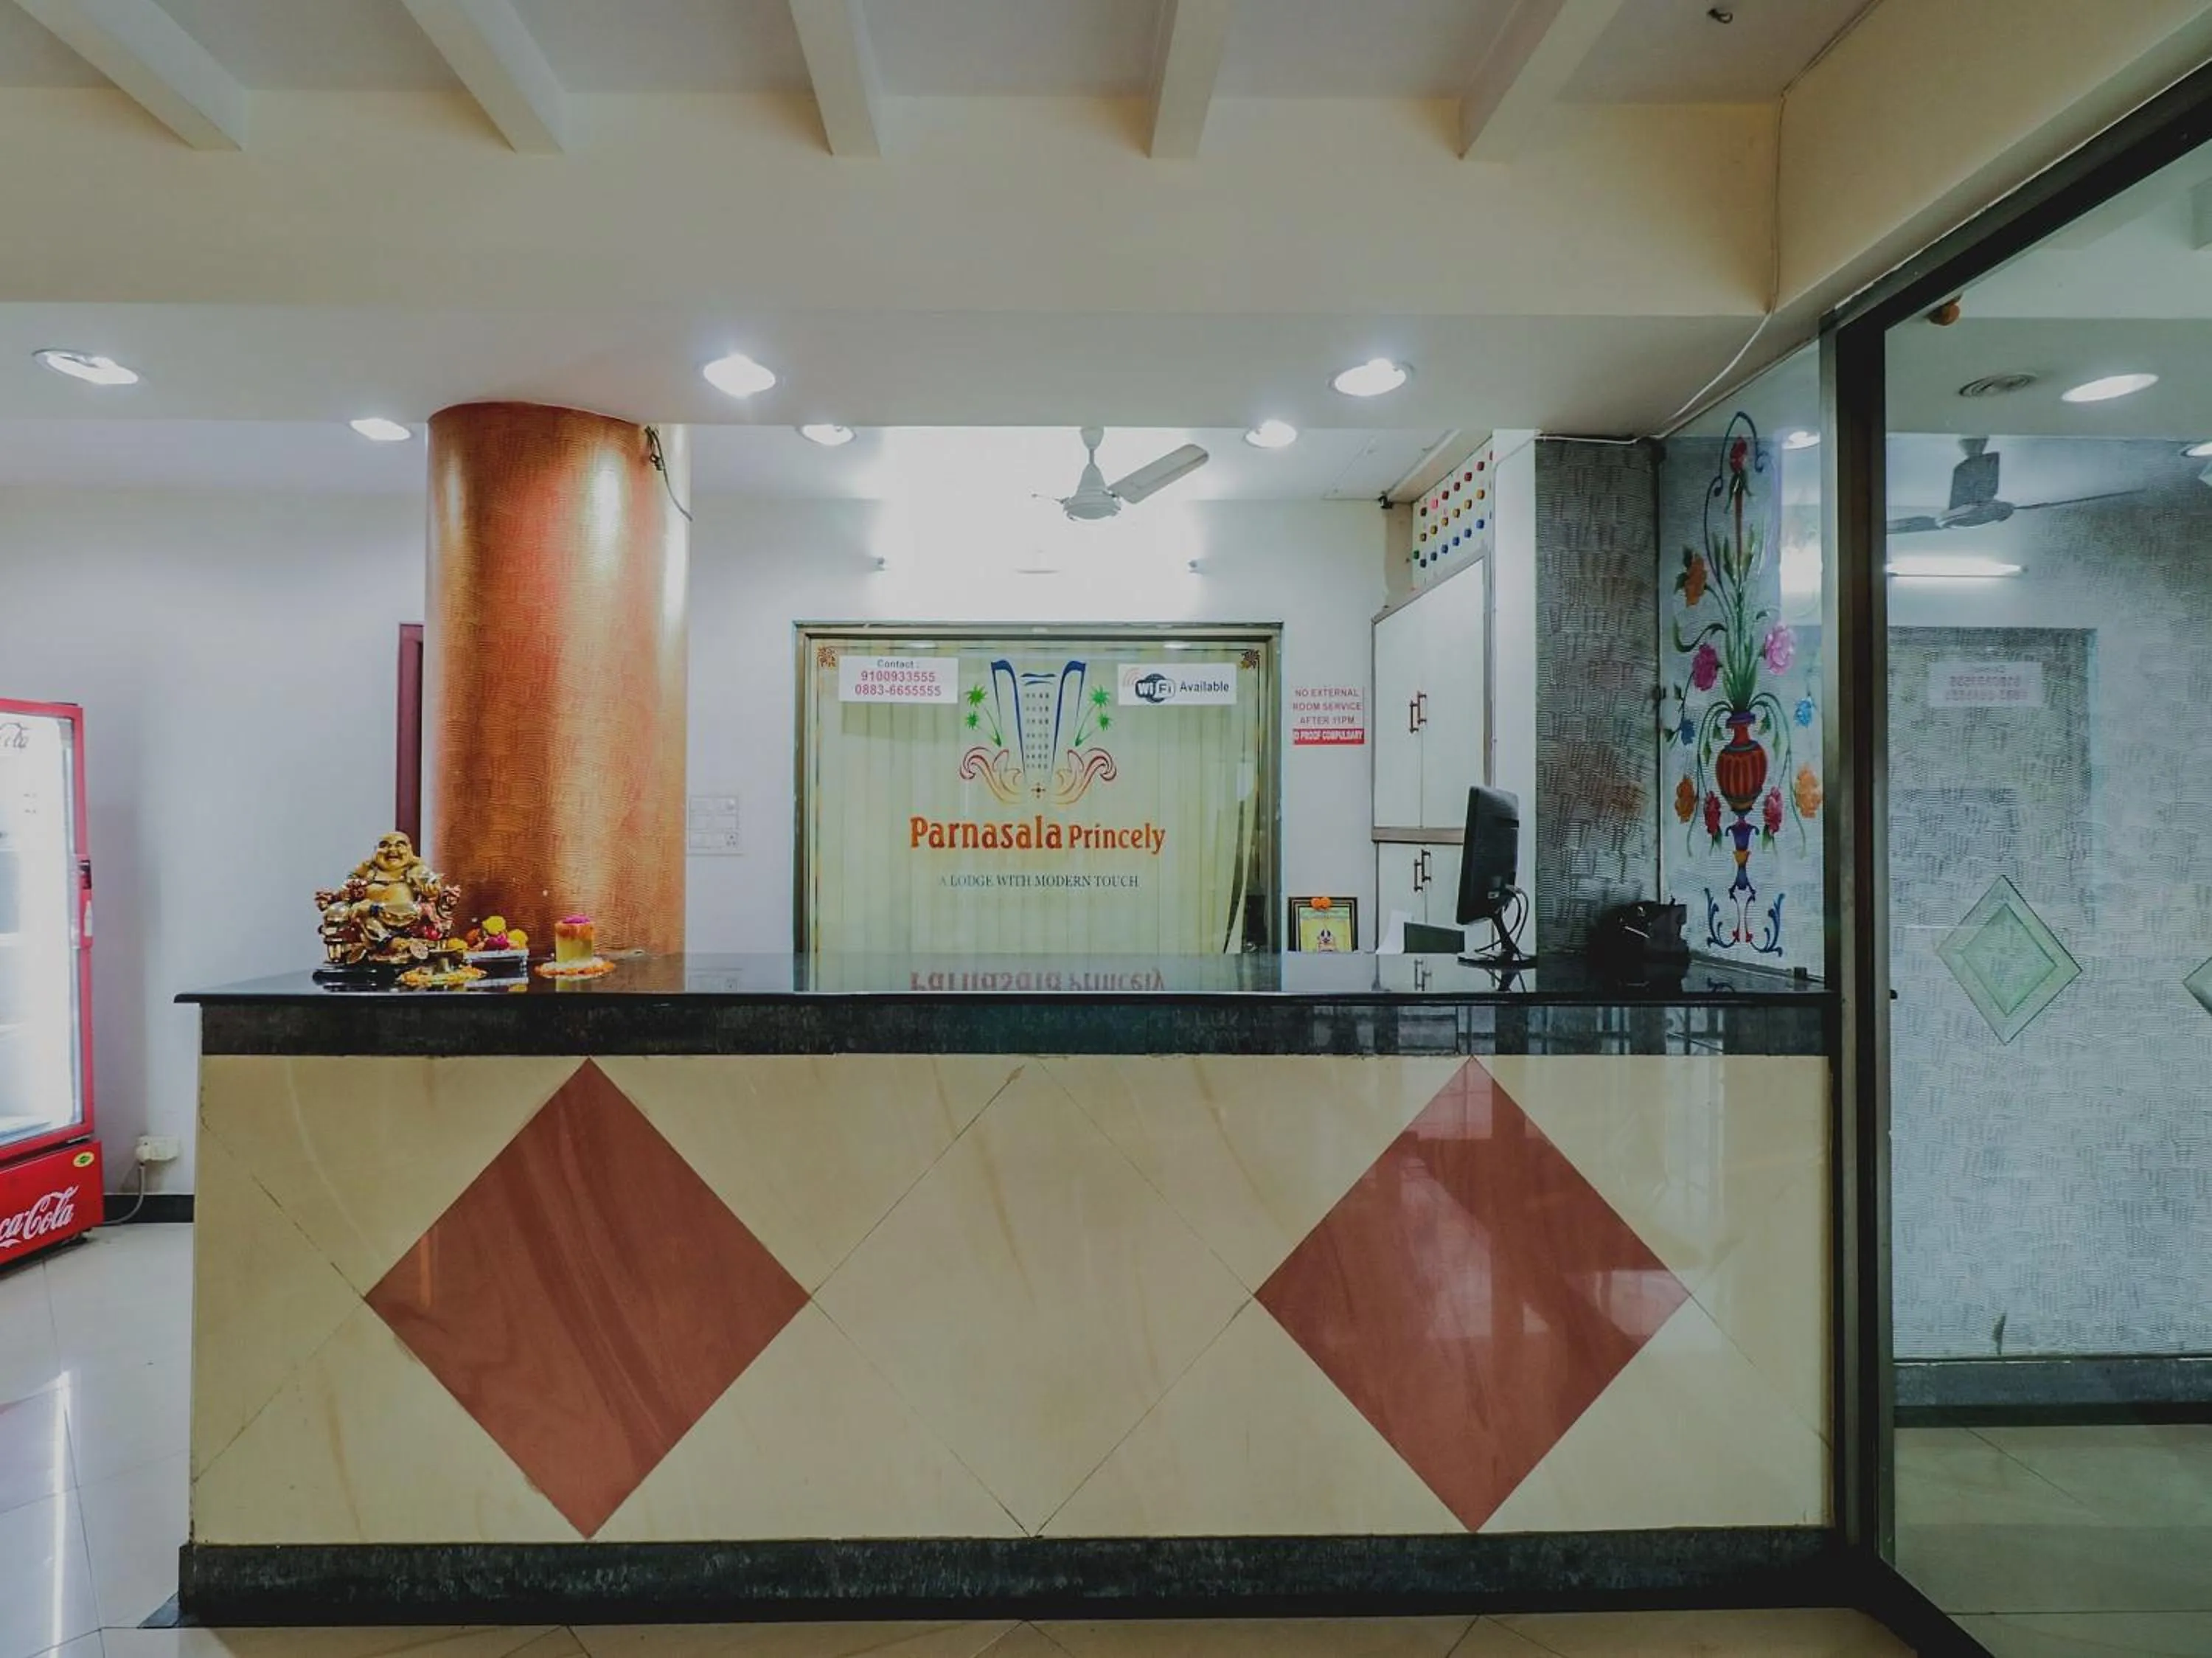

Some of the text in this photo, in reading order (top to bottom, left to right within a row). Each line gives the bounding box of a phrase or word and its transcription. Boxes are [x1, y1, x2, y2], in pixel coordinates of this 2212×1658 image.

[877, 659, 914, 668] Contact
[860, 670, 936, 682] 9100933555
[1180, 681, 1230, 693] Available
[1295, 687, 1360, 697] NO EXTERNAL
[1293, 701, 1363, 711] ROOM SERVICE
[1300, 716, 1329, 725] AFTER
[910, 814, 1166, 855] Parnasala Princely
[950, 875, 992, 887] LODGE
[996, 875, 1032, 887] WITH
[1035, 875, 1091, 887] MODERN
[1094, 875, 1138, 887] TOUCH
